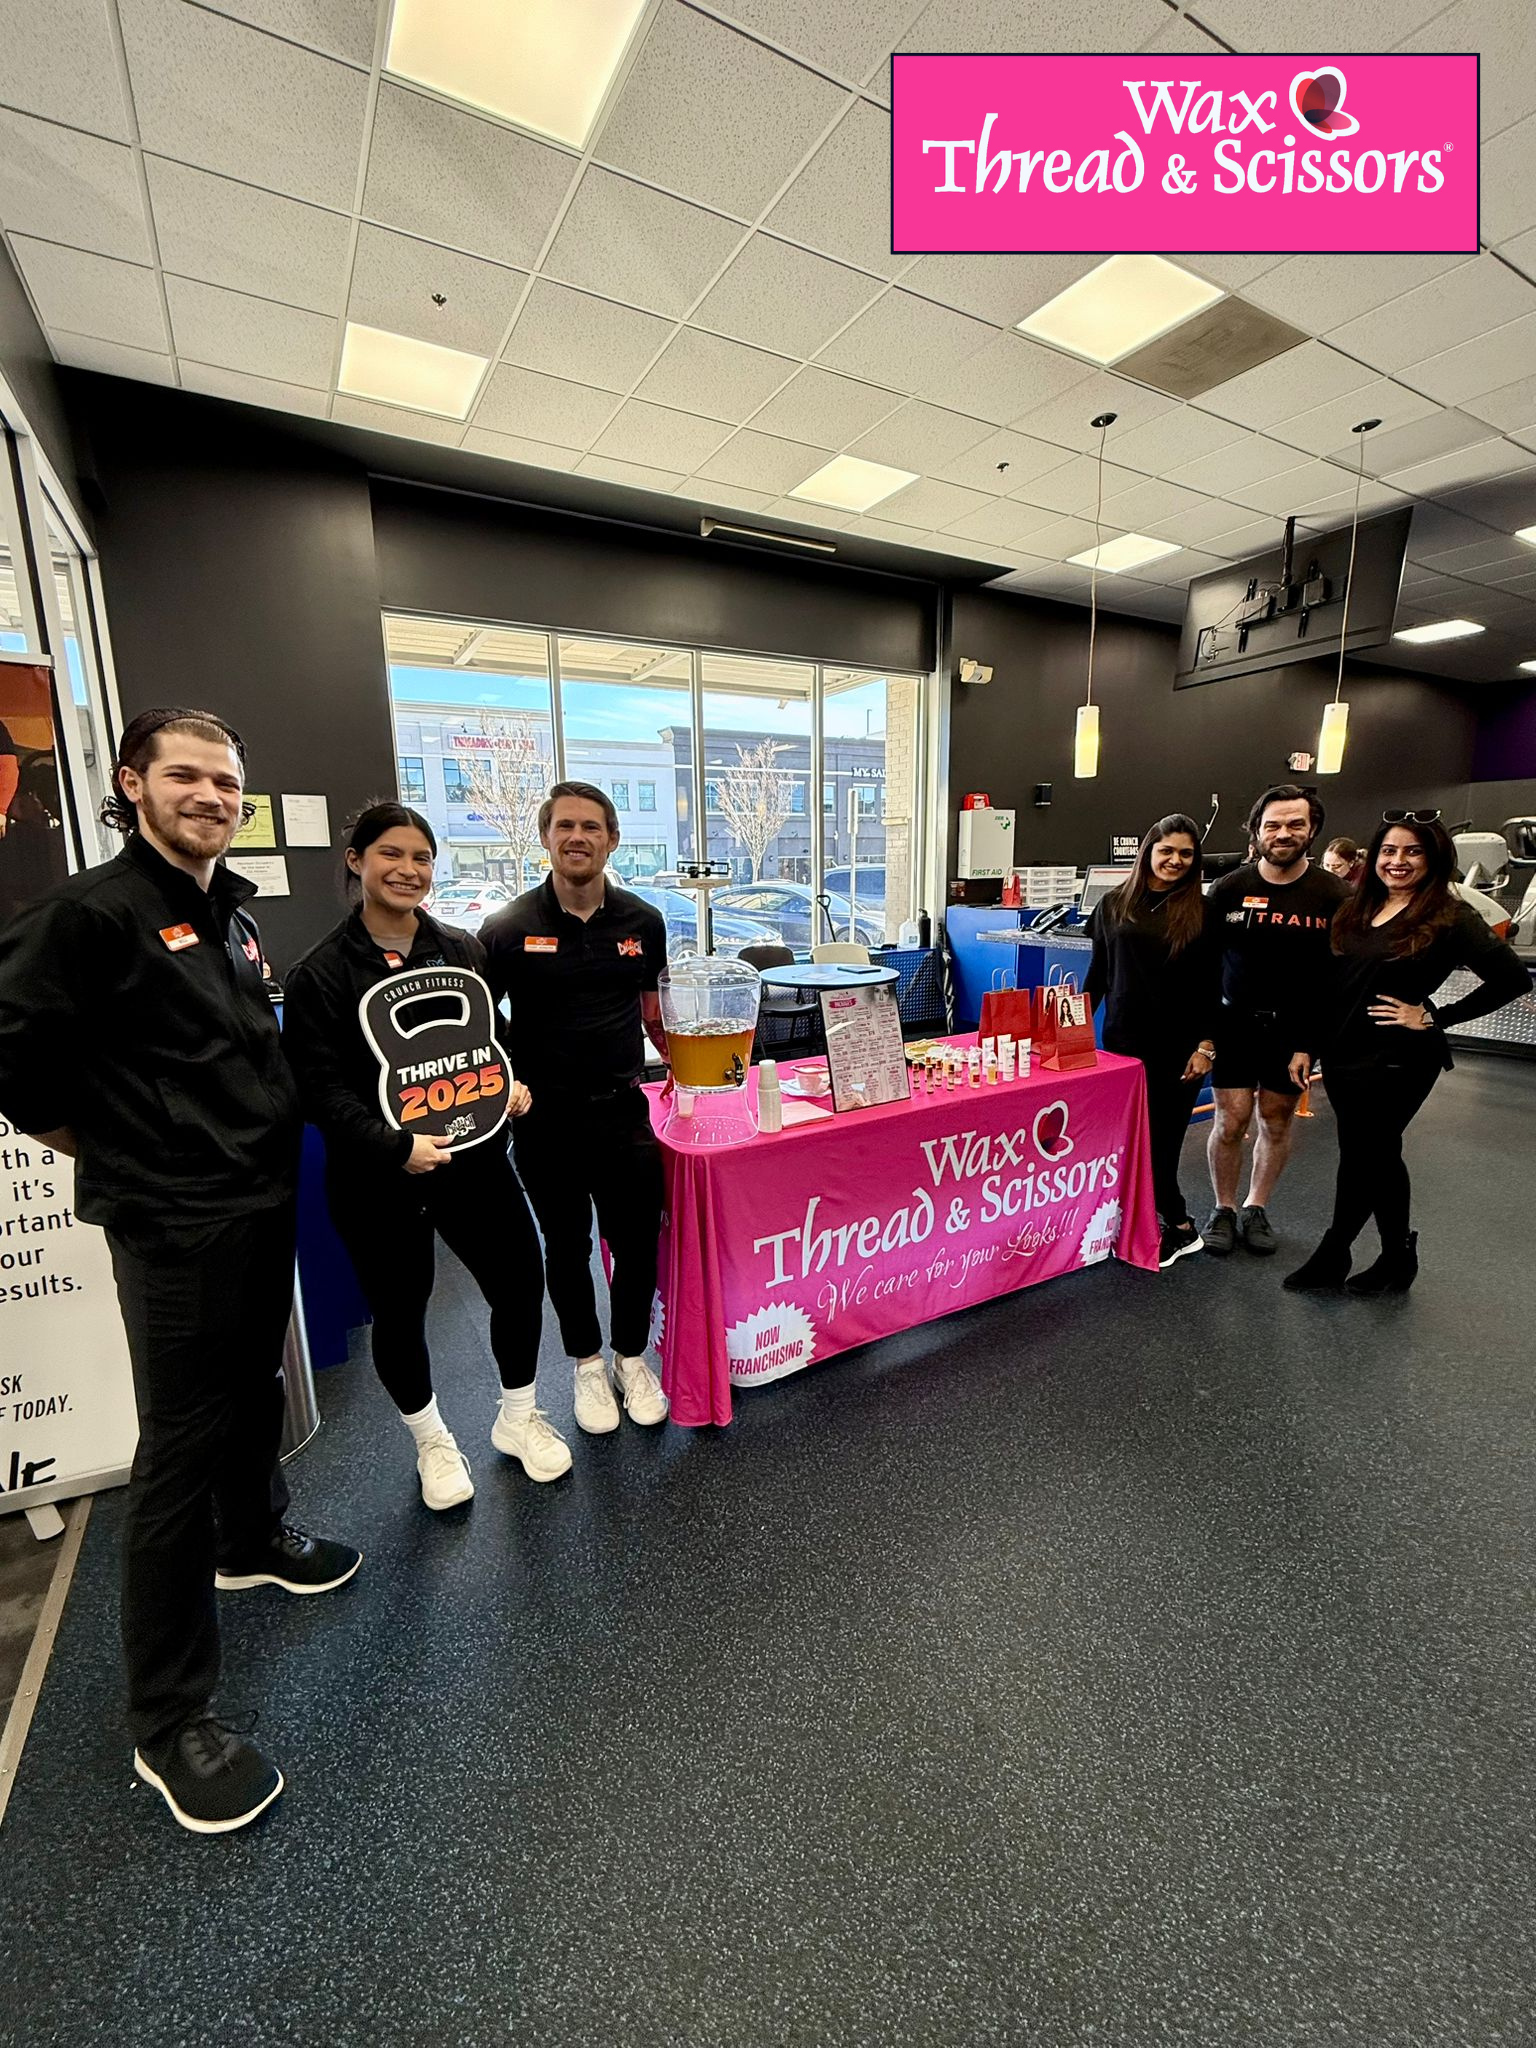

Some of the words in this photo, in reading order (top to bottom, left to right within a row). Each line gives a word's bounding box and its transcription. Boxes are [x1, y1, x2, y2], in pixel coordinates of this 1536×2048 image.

[991, 868, 1002, 876] AID
[1256, 912, 1327, 929] TRAIN
[384, 980, 421, 1002] CRUNCH
[426, 977, 464, 988] FITNESS
[396, 1052, 468, 1085] THRIVE
[472, 1046, 491, 1066] IN
[398, 1063, 504, 1123] 2025
[41, 1149, 54, 1165] a
[920, 1128, 1026, 1186] Wax
[13, 1179, 55, 1202] it's
[754, 1187, 935, 1288] Thread
[945, 1197, 971, 1234] &
[817, 1265, 873, 1324] We
[874, 1269, 920, 1300] care
[925, 1248, 955, 1283] for
[950, 1244, 1000, 1289] your
[755, 1324, 781, 1351] NOW
[729, 1340, 804, 1375] FRANCHISING
[13, 1394, 73, 1422] TODAY.
